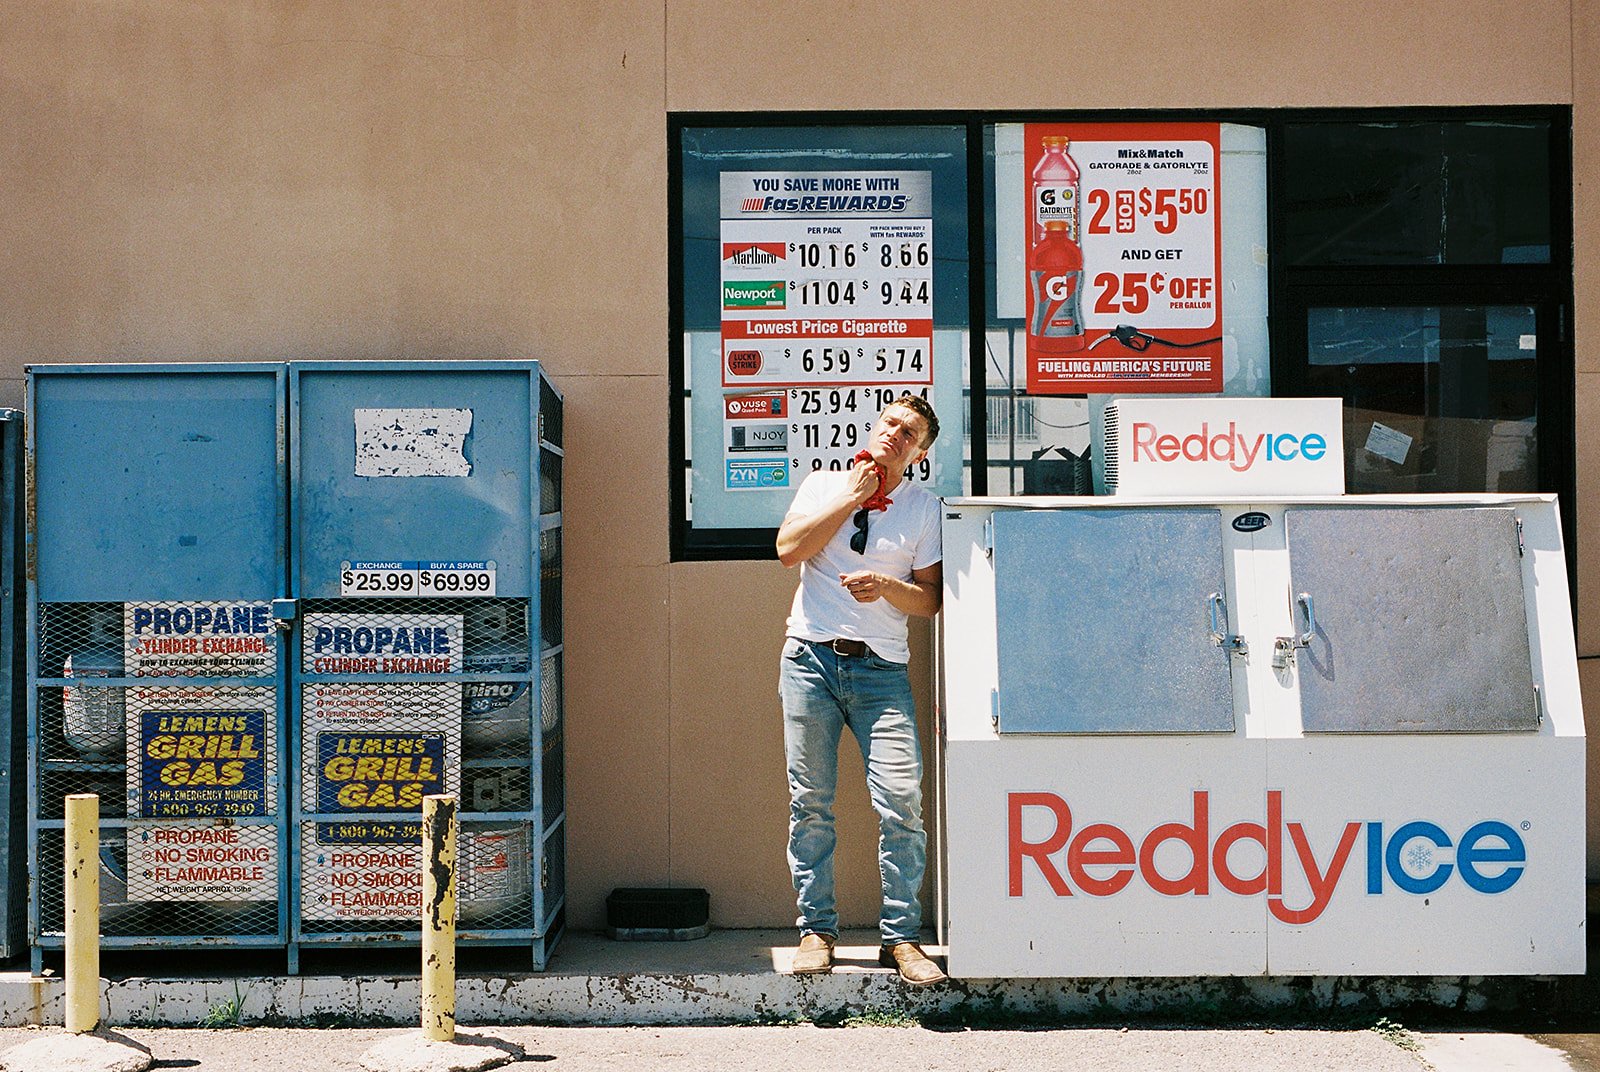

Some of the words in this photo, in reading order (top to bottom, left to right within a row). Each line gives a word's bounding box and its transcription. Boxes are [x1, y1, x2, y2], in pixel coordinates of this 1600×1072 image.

[1118, 149, 1184, 159] Mix&Match
[1089, 162, 1142, 170] GATORADE
[1144, 162, 1151, 170] &
[753, 178, 780, 191] YOU
[784, 178, 818, 191] SAVE
[822, 178, 862, 191] MORE
[865, 178, 900, 191] WITH
[1039, 206, 1073, 214] GATORLYTE
[1088, 188, 1111, 235] 2
[1118, 193, 1133, 232] FOR
[731, 245, 777, 265] Marlboro
[1120, 249, 1151, 260] AND
[1154, 249, 1183, 260] GET
[724, 287, 776, 301] Newport
[1169, 277, 1212, 299] OFF
[1169, 301, 1184, 309] PER
[1184, 301, 1212, 309] GALLON
[746, 320, 798, 335] Lowest
[801, 320, 838, 334] Price
[842, 319, 908, 336] Cigarette
[733, 353, 756, 362] LUCKY
[732, 361, 758, 370] STRIKE
[1038, 361, 1091, 373] FUELING
[1092, 360, 1161, 373] AMERICA'S
[1162, 360, 1212, 372] FUTURE
[753, 431, 785, 441] NJOY
[729, 468, 759, 481] ZYN
[356, 562, 403, 570] EXCHANGE
[430, 562, 447, 570] BUY
[449, 562, 456, 570] A
[457, 562, 484, 570] SPARE
[342, 570, 414, 592] $25.99
[419, 570, 491, 592] $69.99
[134, 606, 269, 635] PROPANE
[314, 626, 451, 654] PROPANE
[314, 657, 378, 673] CYLINDER
[382, 657, 451, 673] EXCHANGE
[158, 715, 248, 733] LEMENS
[146, 734, 260, 760] GRILL
[335, 737, 426, 754] LEMENS
[159, 760, 246, 787] GAS
[323, 756, 438, 781] GRILL
[174, 789, 223, 801] EMERGENCY
[224, 789, 259, 801] NUMBER
[336, 782, 424, 808] GAS
[154, 830, 239, 844] PROPANE
[154, 849, 181, 863] NO
[185, 847, 270, 862] SMOKING
[331, 853, 416, 868] PROPANE
[155, 866, 264, 881] FLAMMABLE
[331, 872, 358, 887] NO
